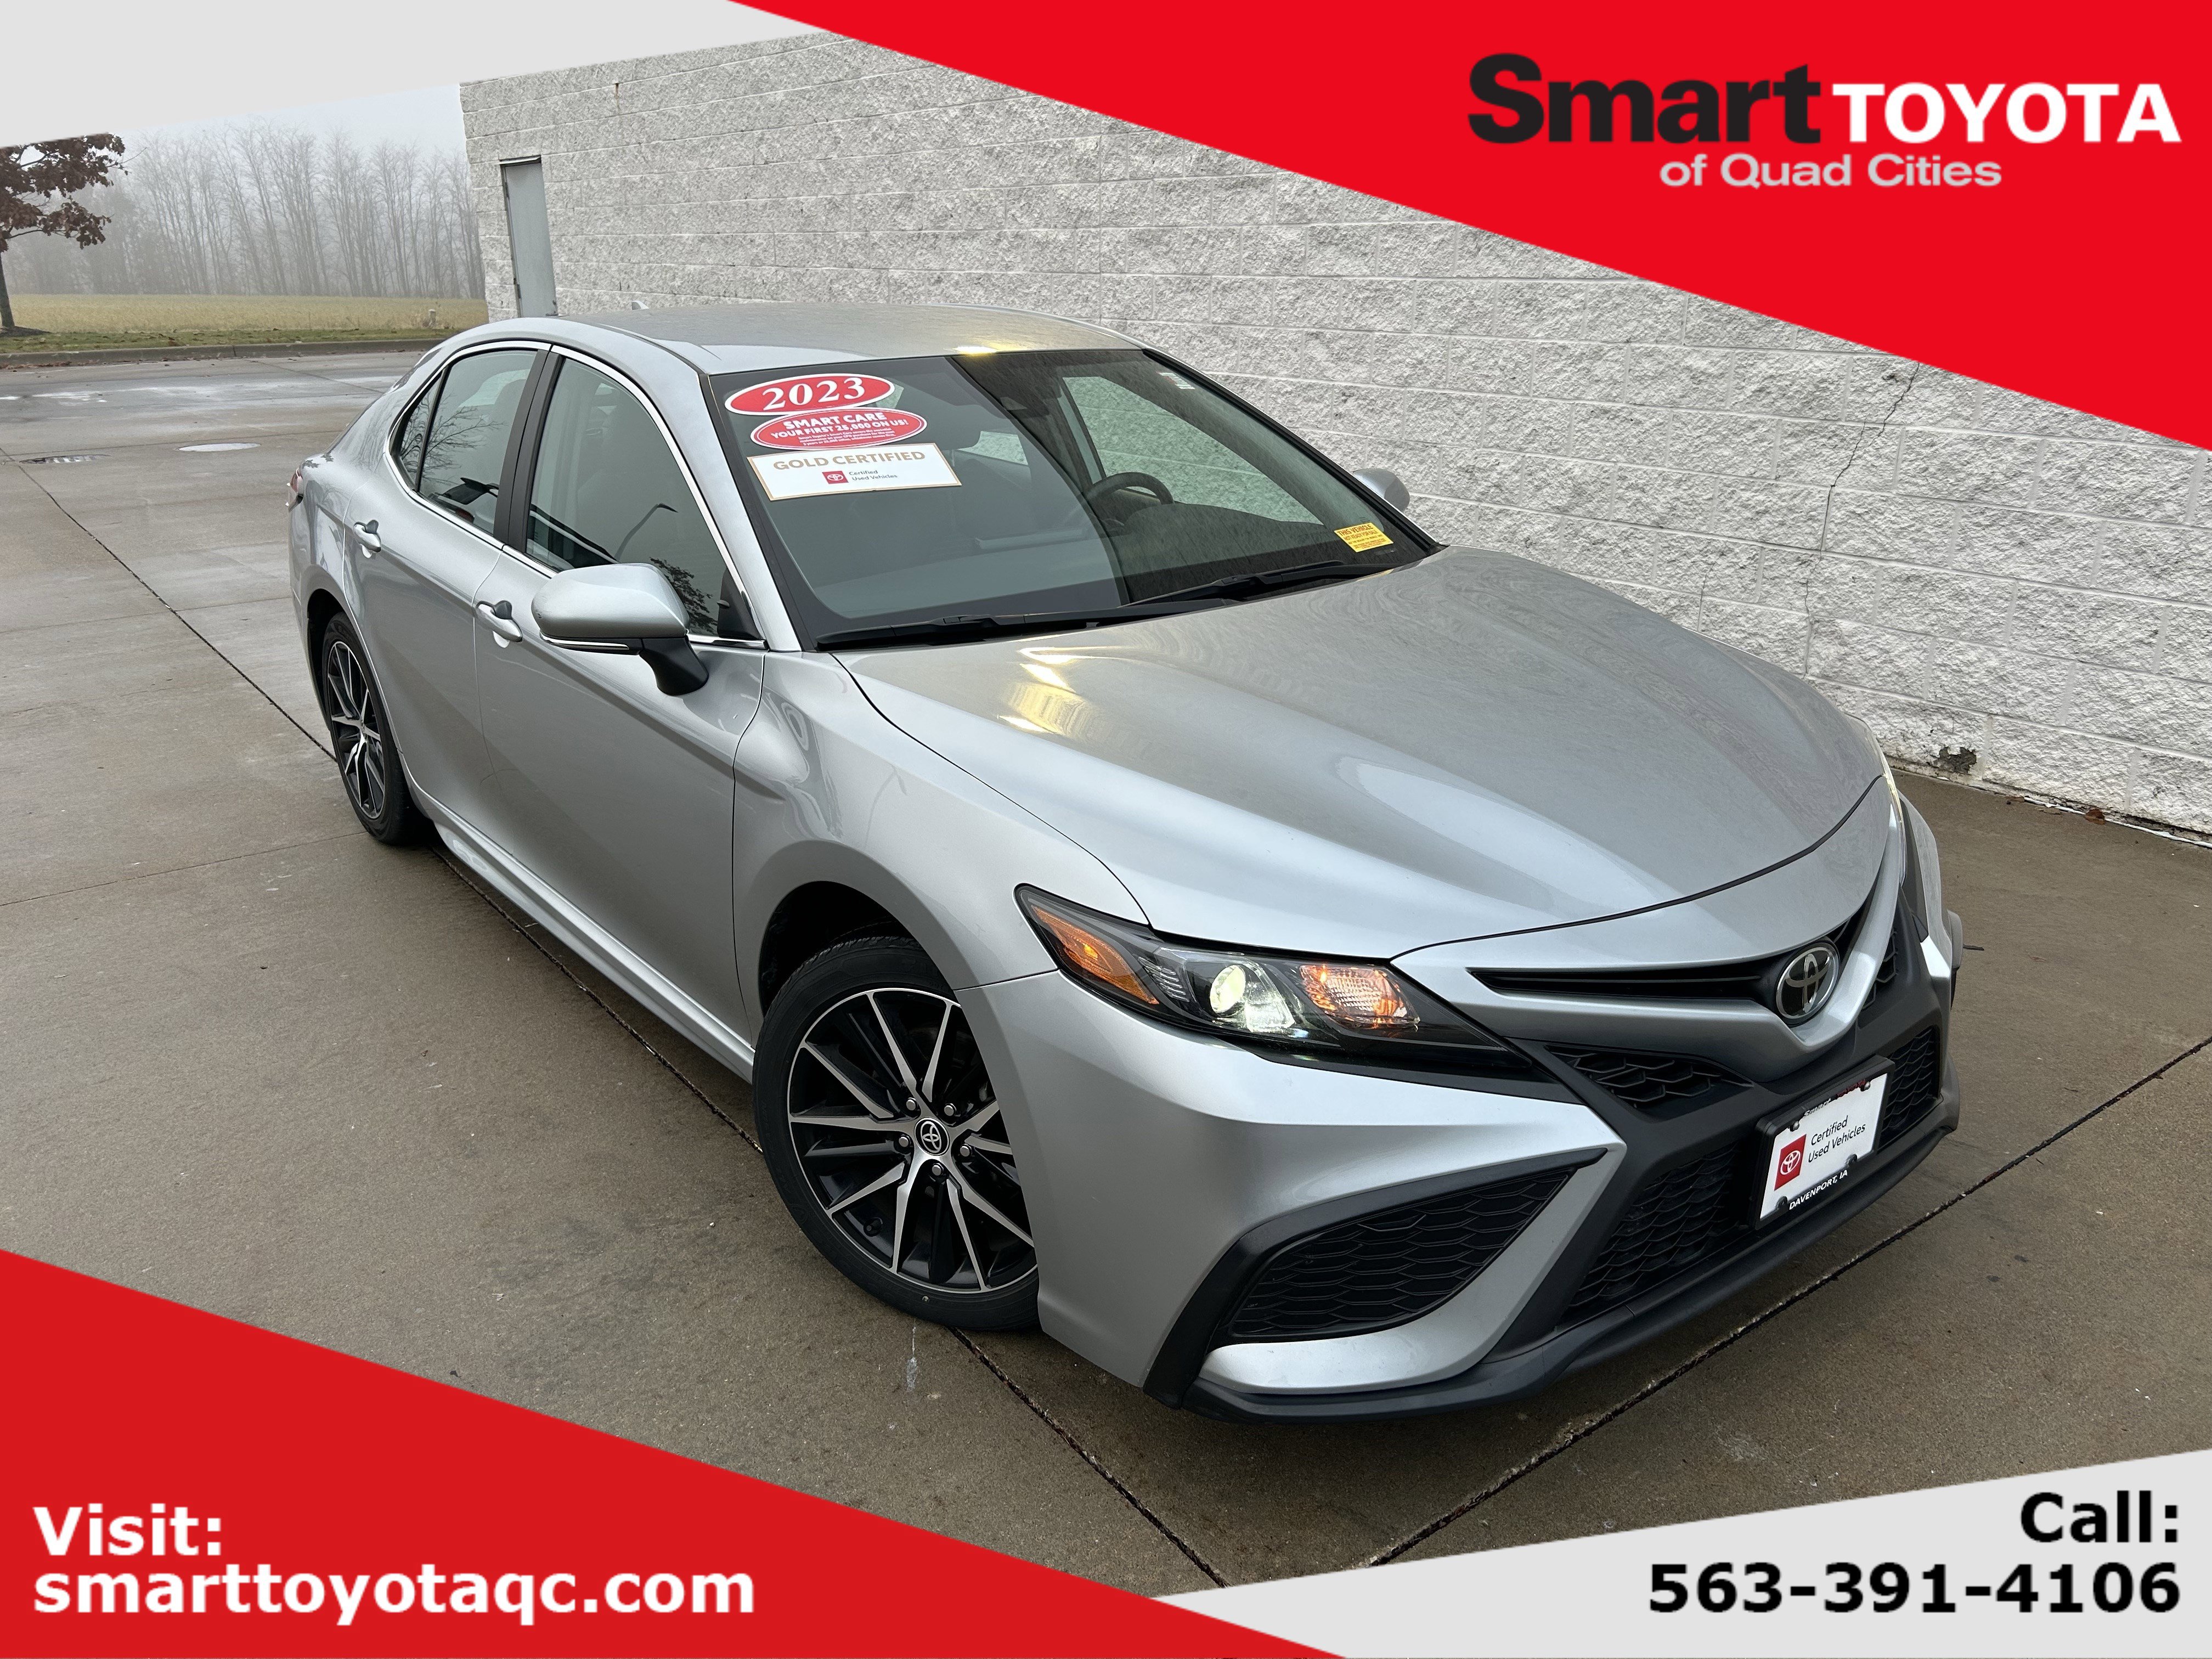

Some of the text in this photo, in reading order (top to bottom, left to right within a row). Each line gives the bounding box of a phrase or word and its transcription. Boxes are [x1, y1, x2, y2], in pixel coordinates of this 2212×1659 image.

[762, 377, 866, 411] 2023
[770, 428, 805, 439] YOUR
[805, 426, 834, 435] FIRST
[837, 422, 872, 432] 25,000
[783, 412, 888, 430] SMART CARE
[774, 452, 926, 470] GOLD CERTIFIED
[1808, 1124, 1866, 1163] Used Vehicles
[1811, 1115, 1849, 1146] Certified
[1789, 1169, 1848, 1210] DAVENPORT, IA
